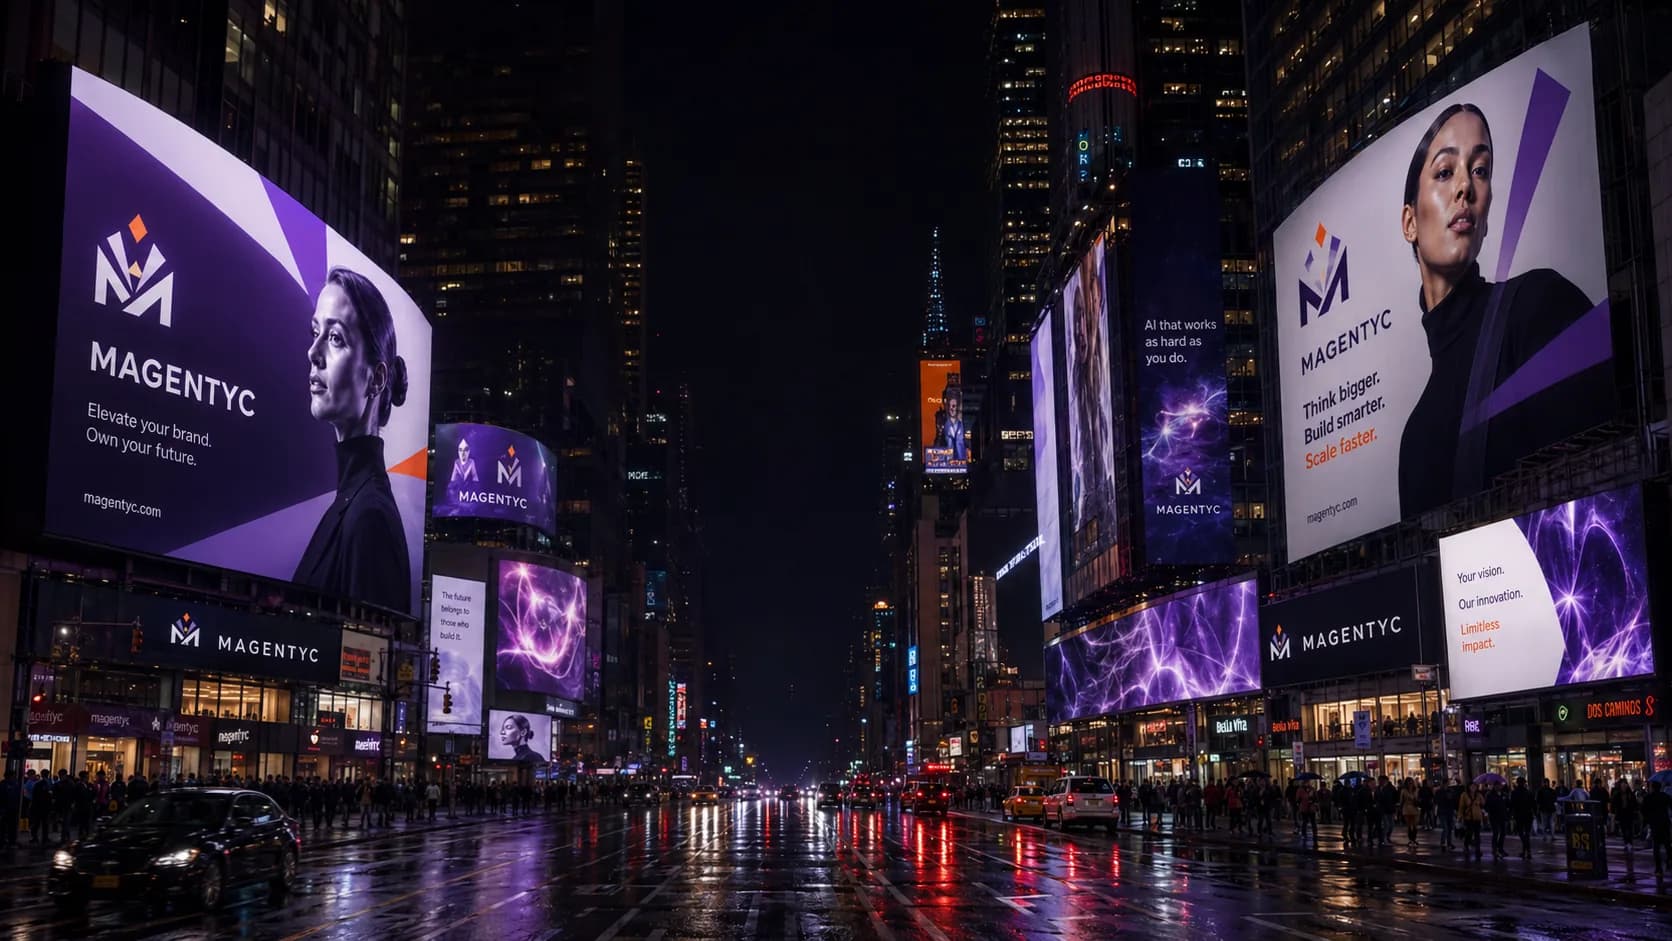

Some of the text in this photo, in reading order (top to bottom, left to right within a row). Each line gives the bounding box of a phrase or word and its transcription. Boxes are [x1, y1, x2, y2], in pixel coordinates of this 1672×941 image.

[1144, 319, 1217, 331] AI that works
[1145, 335, 1202, 347] as hard as
[1300, 309, 1393, 376] MAGENTYC
[1145, 352, 1188, 367] you do.
[90, 340, 256, 417] MAGENTYC
[1303, 371, 1380, 420] Think bigger.
[88, 402, 212, 448] Elevate your brand.
[1304, 395, 1385, 446] Build smarter.
[86, 426, 197, 466] Own your future.
[1305, 427, 1378, 470] Scale faster.
[83, 492, 161, 519] magentyc.com
[459, 490, 528, 509] MAGENTYC
[1156, 505, 1221, 515] MAGENTYC
[1306, 496, 1358, 524] magentyc.com
[1456, 564, 1505, 584] Your vision.
[453, 592, 472, 602] future
[1458, 587, 1524, 610] Our innovation.
[441, 604, 471, 616] belongs to
[440, 619, 457, 628] those
[1460, 618, 1500, 636] Limitless
[440, 631, 456, 641] build
[1302, 616, 1402, 652] MAGENTYC
[218, 634, 320, 664] MAGENTYC
[1461, 637, 1496, 654] impact.
[1587, 703, 1603, 720] DOS
